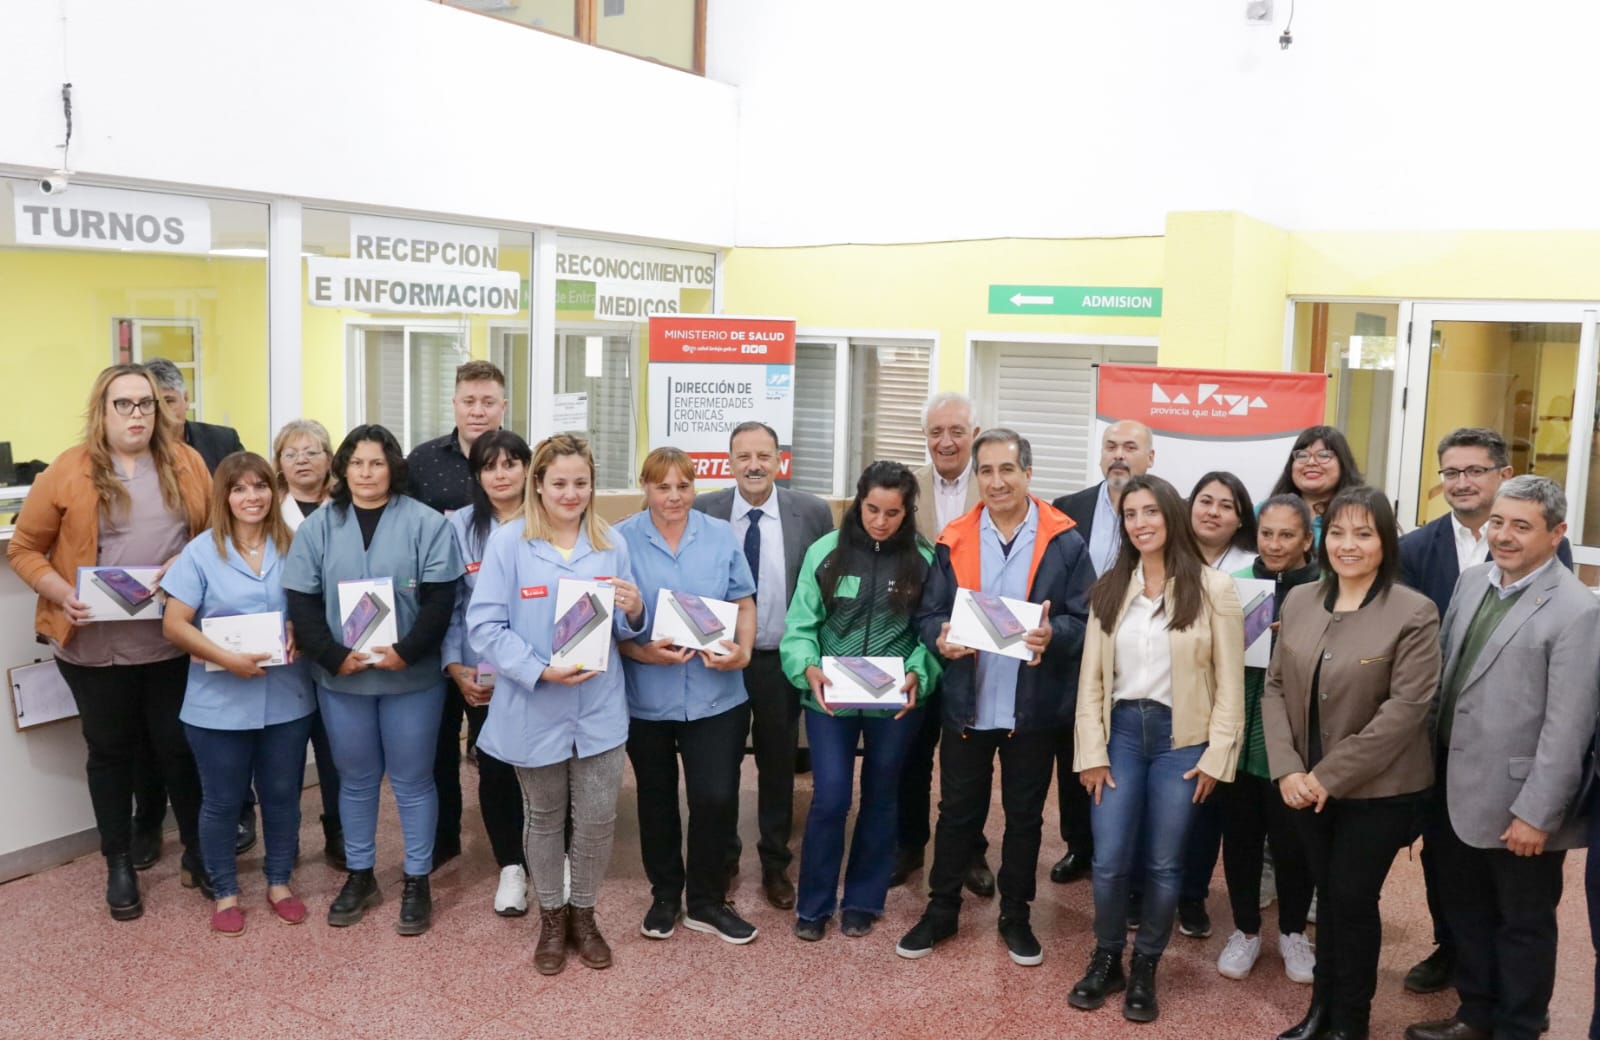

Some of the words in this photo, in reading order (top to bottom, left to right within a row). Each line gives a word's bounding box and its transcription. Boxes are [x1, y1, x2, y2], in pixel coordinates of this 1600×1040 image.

[23, 204, 185, 246] TURNOS
[356, 234, 498, 269] RECEPCION
[556, 253, 713, 285] RECONOCIMIENTOS
[315, 276, 332, 301] E
[344, 276, 519, 310] INFORMACION
[600, 295, 678, 317] MEDICOS
[1082, 295, 1153, 309] ADMISION
[664, 329, 728, 340] MINISTERIO
[730, 330, 745, 341] DE
[748, 331, 785, 341] SALUD
[675, 379, 735, 394] DIRECCIÓN
[738, 382, 752, 394] DE
[675, 397, 754, 409] ENFERMEDADES
[1150, 406, 1190, 418] provincia
[1192, 408, 1209, 419] que
[1211, 408, 1228, 417] late
[674, 421, 689, 433] NO
